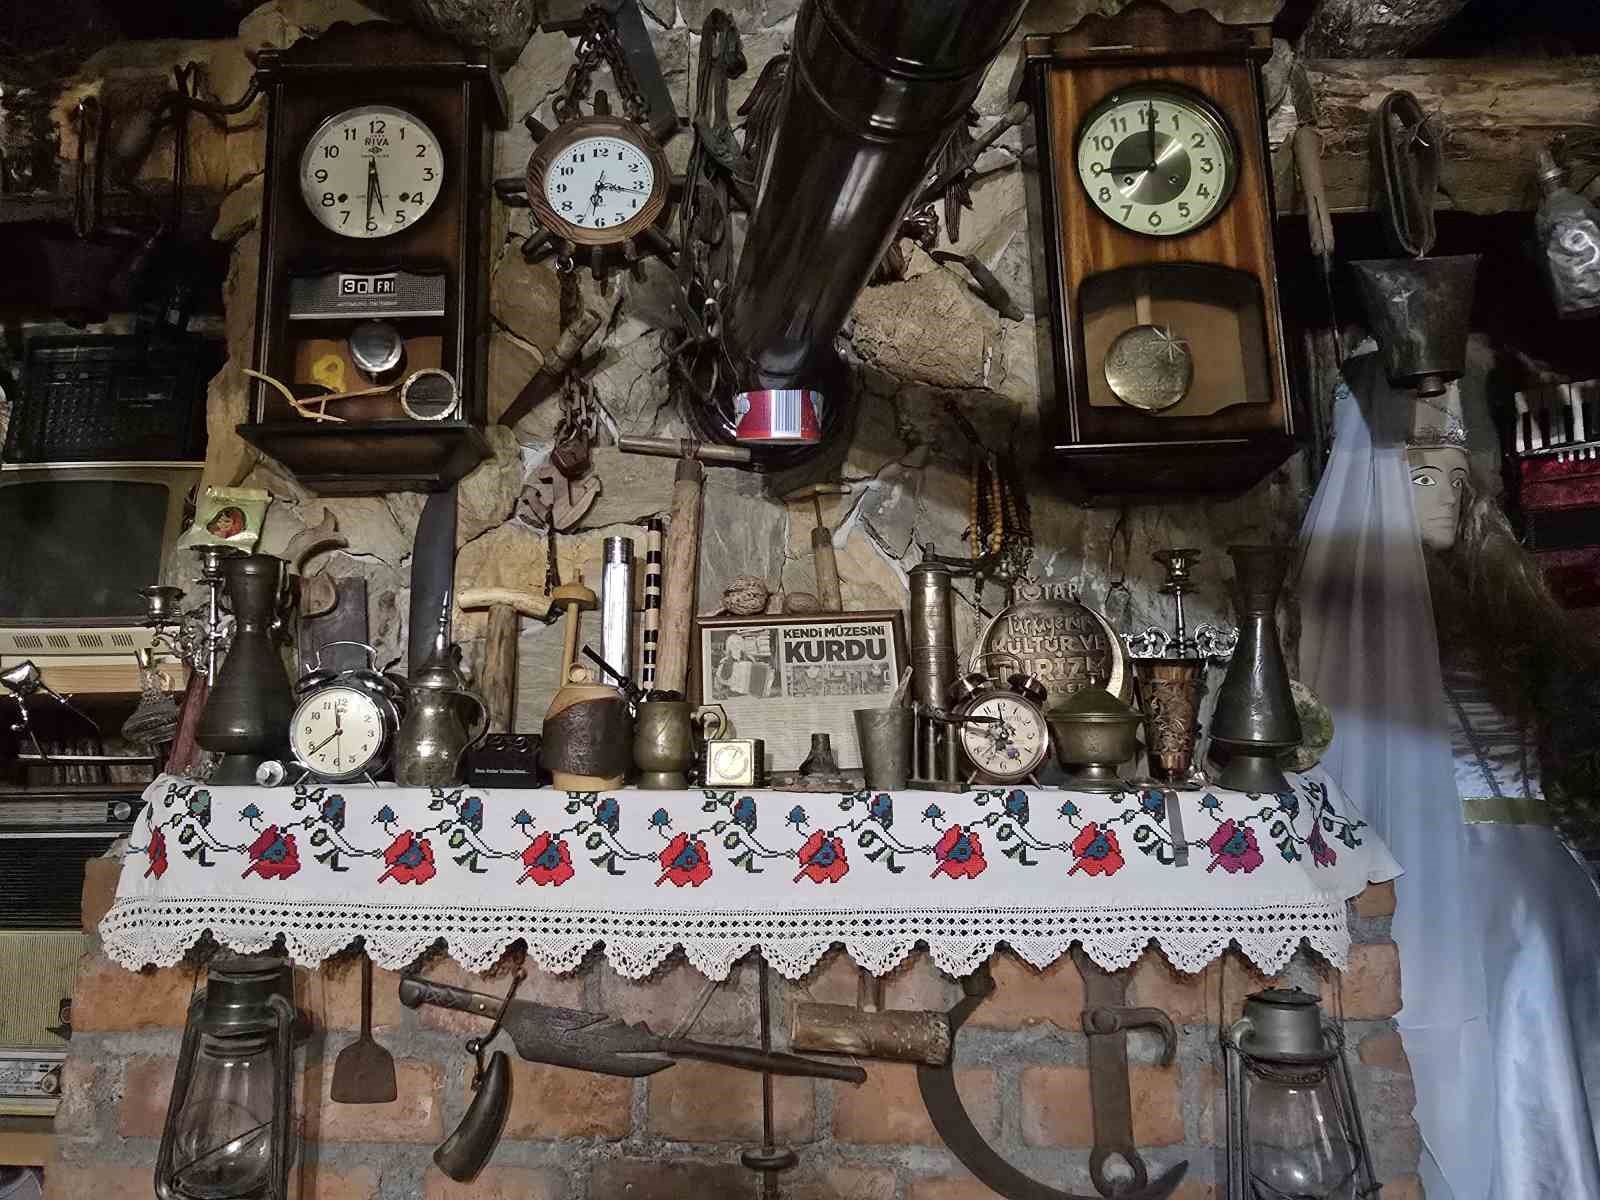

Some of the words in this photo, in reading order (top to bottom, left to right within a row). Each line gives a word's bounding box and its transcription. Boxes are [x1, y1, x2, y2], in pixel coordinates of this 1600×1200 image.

[1138, 108, 1160, 125] 12
[1171, 114, 1180, 131] 1
[369, 120, 386, 134] 12
[1110, 116, 1127, 132] 11
[343, 127, 357, 140] 11
[399, 127, 405, 140] 1
[1191, 132, 1206, 149] 2
[364, 136, 389, 146] RIVA
[1092, 135, 1114, 151] 10
[324, 145, 340, 158] 10
[415, 144, 427, 158] 2
[572, 153, 585, 163] 11
[593, 147, 609, 158] 12
[618, 152, 623, 160] 1
[560, 166, 574, 176] 10
[628, 163, 639, 173] 2
[1090, 162, 1104, 178] 9
[1200, 157, 1213, 174] 3
[314, 168, 328, 183] 9
[422, 167, 434, 182] 3
[556, 183, 567, 193] 9
[633, 180, 645, 190] 3
[1196, 183, 1210, 199] 4
[321, 192, 336, 207] 8
[410, 192, 425, 206] 4
[1099, 186, 1112, 202] 8
[561, 200, 573, 212] 8
[1120, 204, 1133, 222] 7
[1177, 202, 1191, 218] 5
[339, 210, 350, 224] 7
[395, 210, 406, 223] 5
[575, 213, 585, 224] 7
[614, 212, 626, 223] 5
[1148, 211, 1162, 227] 6
[366, 217, 378, 231] 6
[343, 279, 368, 294] 30
[376, 280, 395, 293] FRI
[784, 638, 887, 664] KURDU
[311, 711, 320, 720] 10
[305, 726, 312, 735] 9
[319, 753, 326, 762] 7
